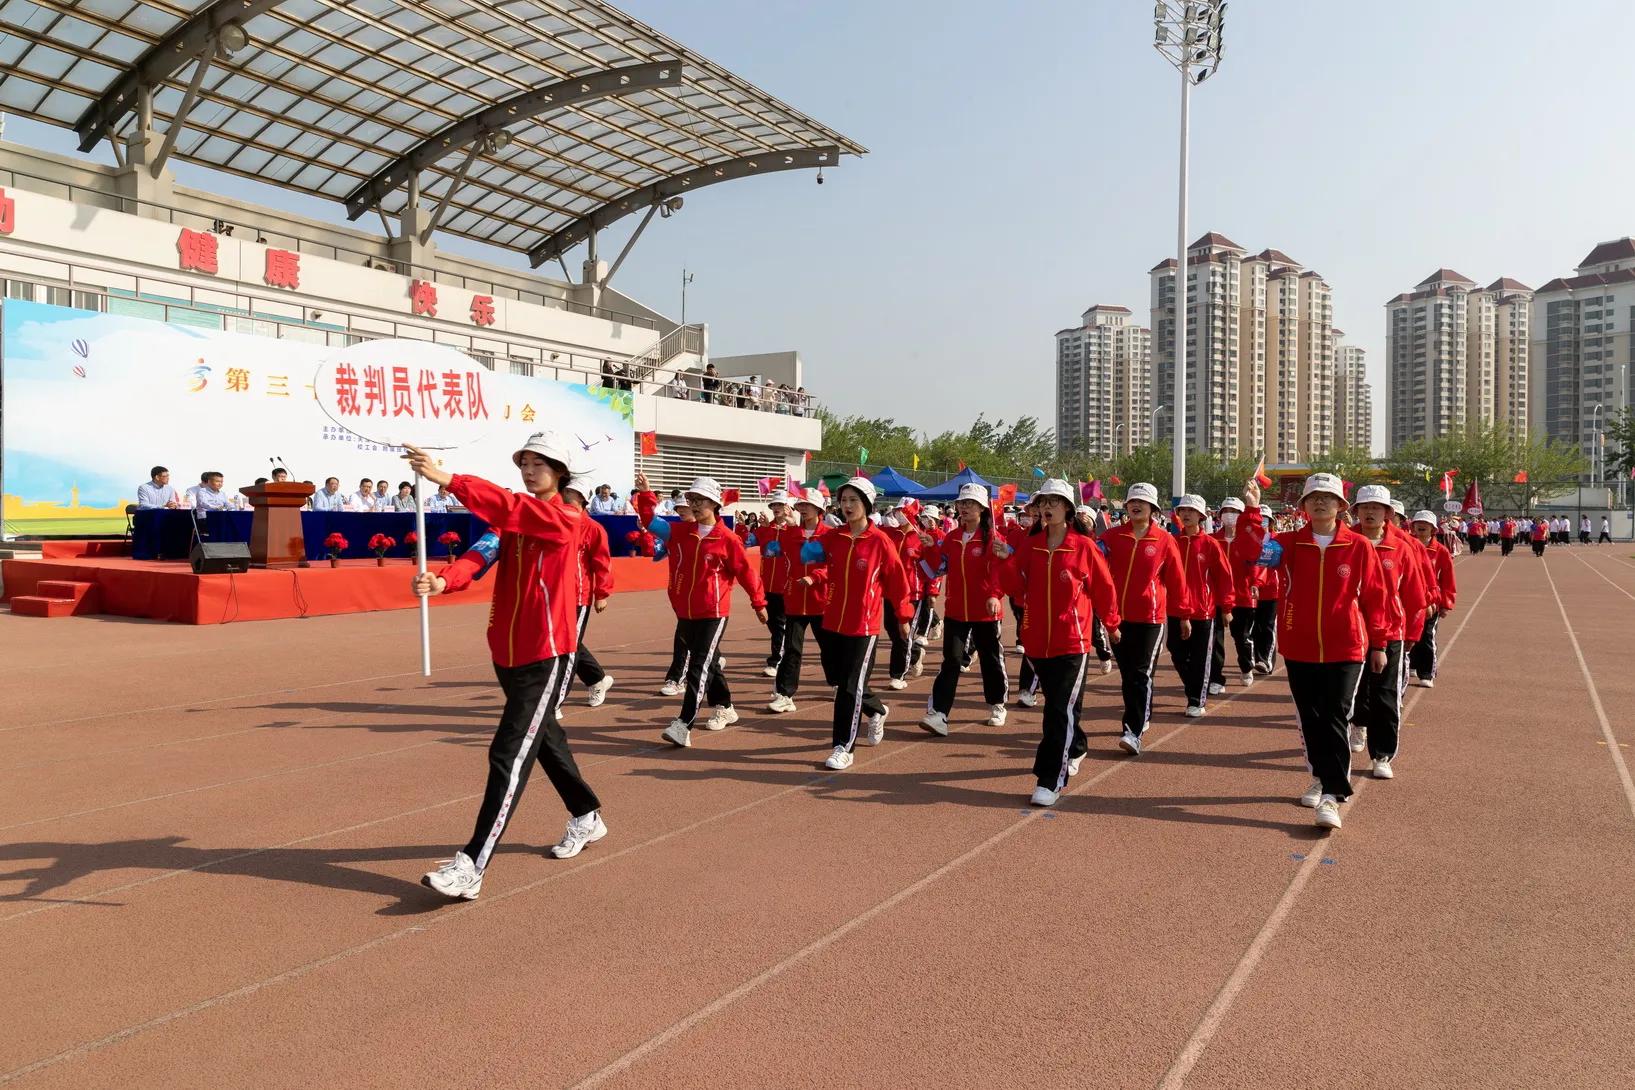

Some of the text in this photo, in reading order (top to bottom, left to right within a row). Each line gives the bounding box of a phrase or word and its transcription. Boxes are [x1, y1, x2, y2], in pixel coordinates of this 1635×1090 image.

[335, 362, 489, 420] 裁判员代表队
[1286, 602, 1294, 631] CHINA
